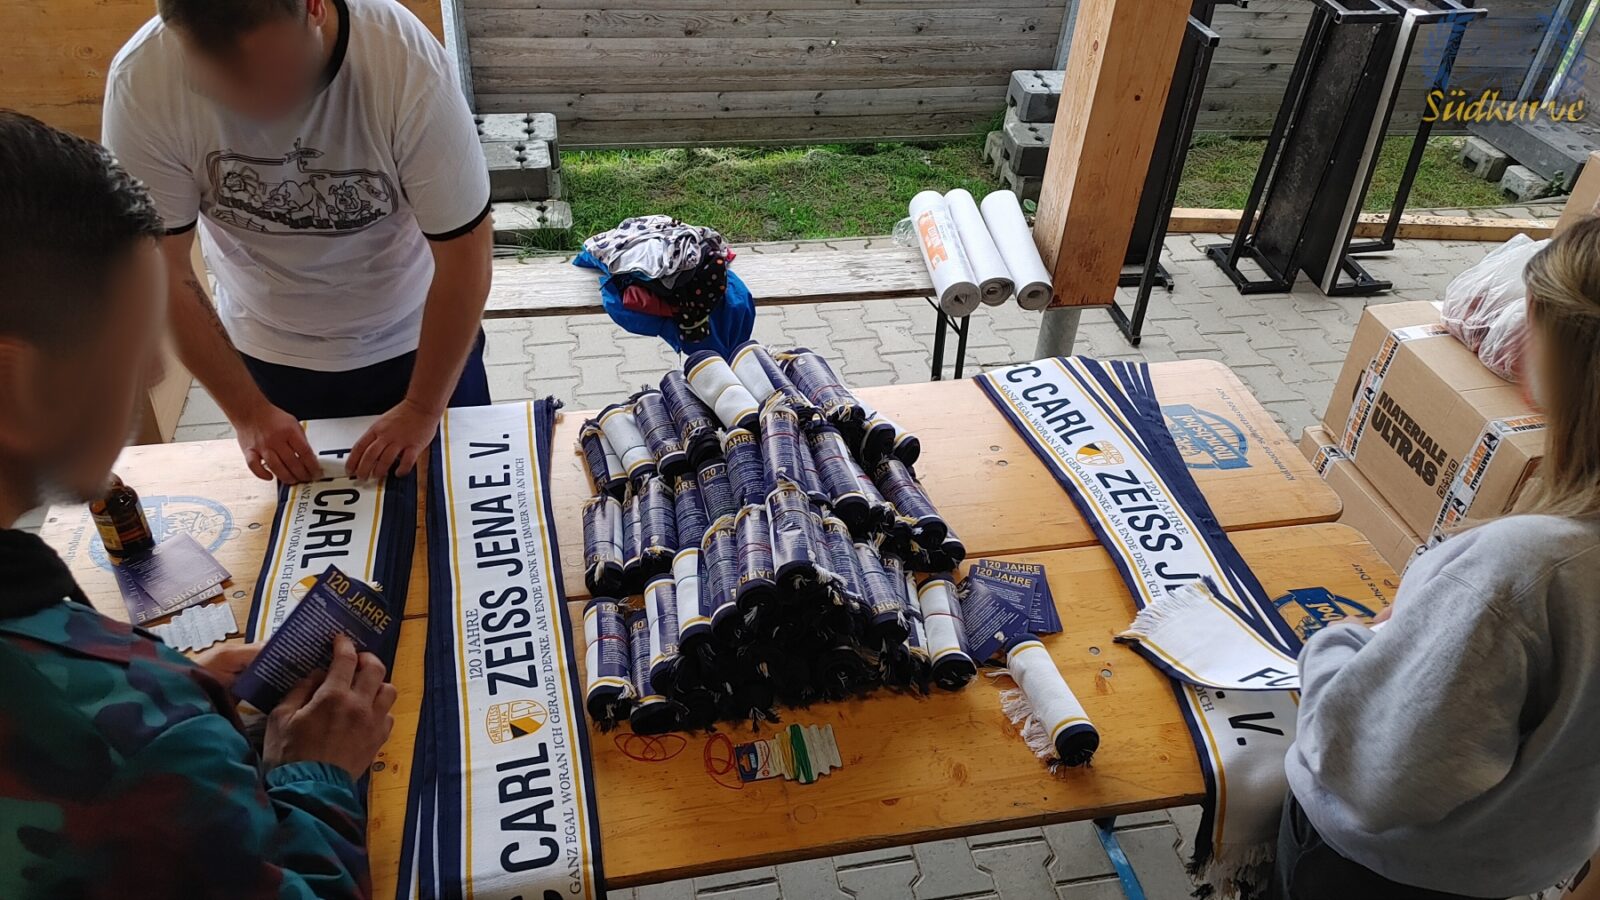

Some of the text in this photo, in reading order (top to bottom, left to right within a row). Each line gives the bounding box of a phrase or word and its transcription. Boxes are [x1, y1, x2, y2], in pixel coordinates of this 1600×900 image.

[1380, 341, 1399, 378] MATERIALE
[469, 433, 510, 459] V.
[1371, 406, 1439, 487] ULTRAS
[1378, 391, 1448, 468] MATERIALE
[469, 464, 511, 489] E.
[515, 457, 525, 477] DICH
[516, 478, 526, 489] AN
[702, 467, 717, 481] 120
[1022, 383, 1095, 446] CARL
[1095, 469, 1183, 552] ZEISS
[1470, 450, 1492, 491] MATERIALE
[517, 491, 528, 509] NUR
[1000, 385, 1019, 403] GANZ
[1016, 402, 1033, 420] EGAL
[1032, 418, 1056, 446] WORAN
[1054, 443, 1069, 460] ICH
[1065, 457, 1093, 486] GERADE
[1108, 511, 1123, 528] AM
[1118, 527, 1138, 551] ENDE
[1133, 551, 1153, 579] DENK
[1147, 580, 1161, 598] ICH
[1143, 480, 1189, 536] 120 JAHRE
[295, 501, 308, 525] EGAL
[301, 489, 360, 569] CARL
[520, 509, 533, 540] IMMER
[286, 526, 303, 561] WORAN
[470, 494, 524, 577] JENA
[525, 540, 536, 557] ICH
[281, 563, 295, 580] ICH
[528, 558, 541, 585] DENK
[976, 567, 1033, 586] 120 JAHRE
[985, 561, 1041, 573] 120 JAHRE
[164, 584, 202, 608] JAHRE
[273, 582, 290, 623] GERADE
[326, 571, 392, 631] 120 JAHRE
[532, 585, 545, 614] ENDE
[602, 604, 619, 613] 120
[536, 615, 548, 631] AM
[466, 608, 483, 680] 120 JAHRE
[479, 586, 539, 696] ZEISS
[545, 675, 561, 723] GERADE
[501, 711, 510, 734] JENA
[552, 727, 565, 749] ICH
[1228, 711, 1285, 746] V.
[556, 753, 573, 805] WORAN
[496, 742, 560, 873] CARL
[563, 807, 577, 844] EGAL
[566, 847, 582, 895] GANZ
